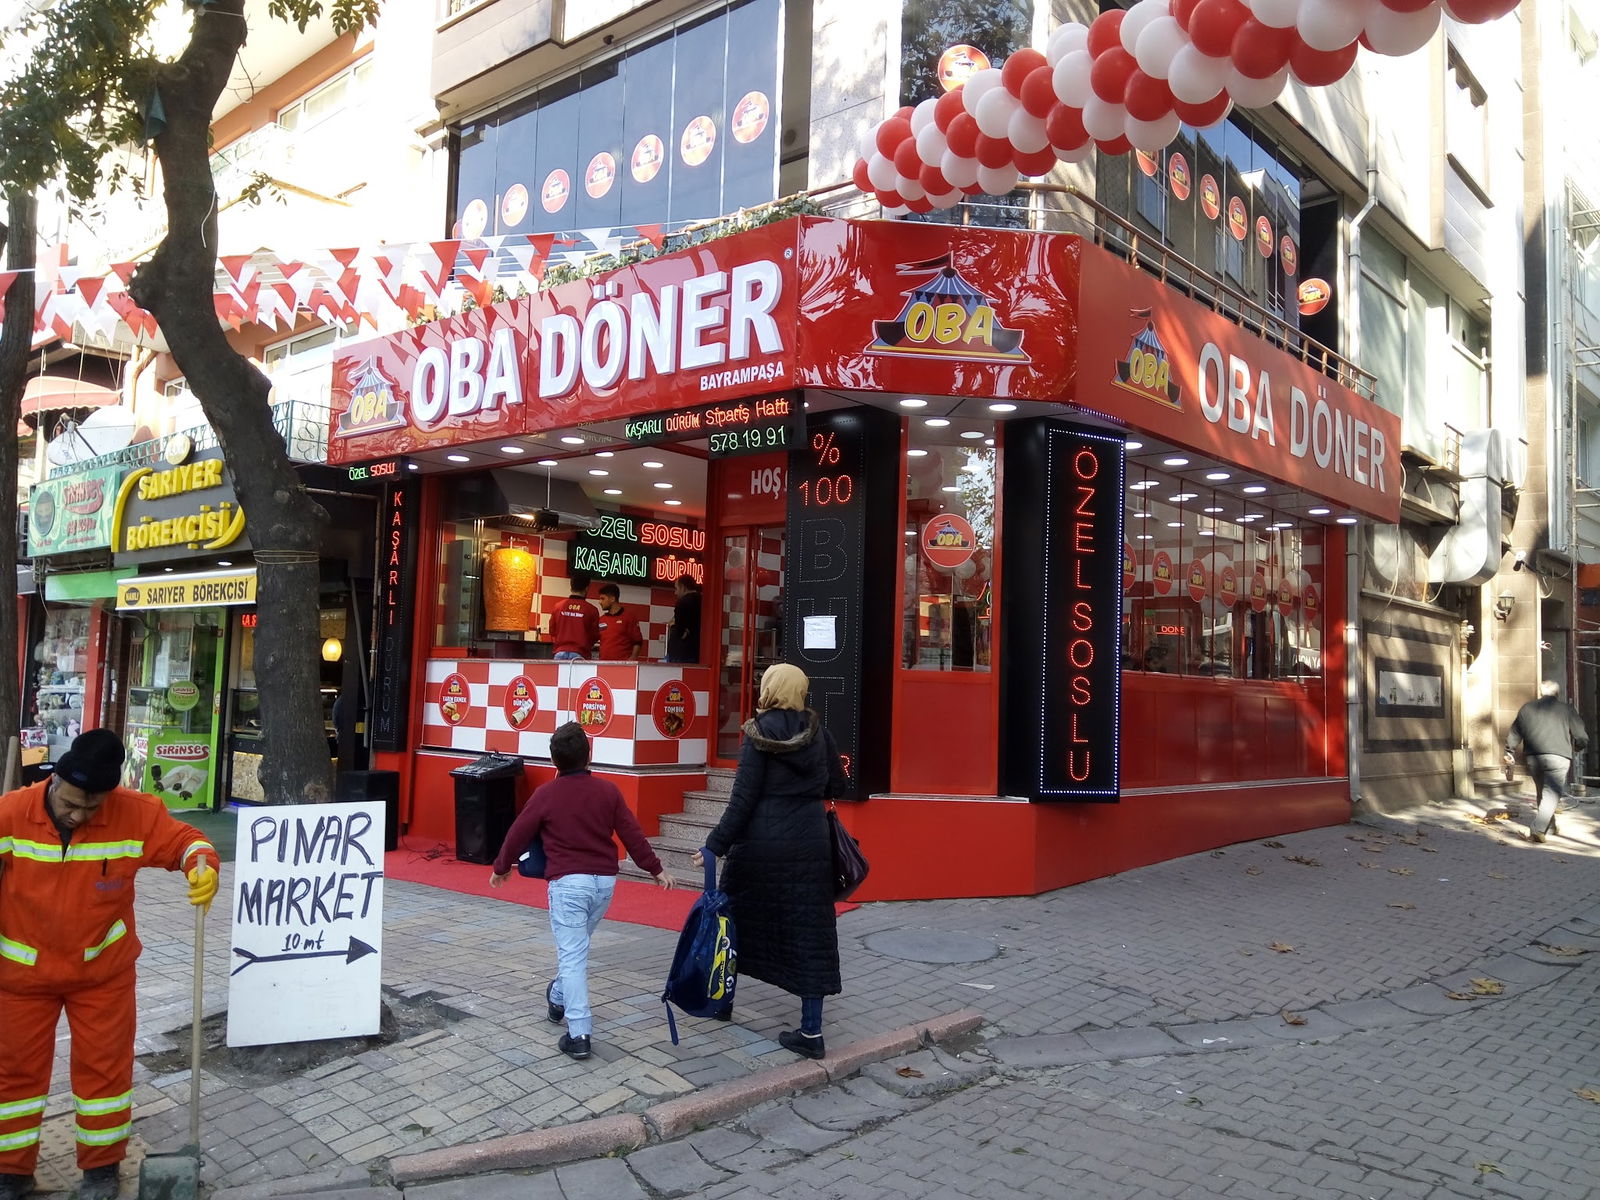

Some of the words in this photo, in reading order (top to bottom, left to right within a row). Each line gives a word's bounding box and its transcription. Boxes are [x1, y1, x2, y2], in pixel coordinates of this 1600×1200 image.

[412, 327, 525, 423] OBA
[539, 259, 786, 400] DÖNER
[904, 301, 994, 346] OBA
[700, 361, 784, 391] BAYRAMPAŞA
[1129, 349, 1170, 391] OBA
[350, 390, 388, 425] OBA
[705, 404, 750, 428] Sipariş
[1199, 342, 1276, 448] OBA
[1289, 385, 1387, 494] DÖNER
[625, 418, 662, 440] KAŞARLI
[710, 431, 739, 452] 578
[743, 428, 761, 449] 19
[766, 425, 785, 446] 91
[812, 431, 841, 467] %
[138, 458, 224, 501] SARIYER
[348, 466, 369, 481] ÖZEL
[370, 462, 396, 477] SOSLU
[751, 466, 781, 499] HOŞ
[799, 474, 852, 506] 100
[126, 501, 232, 551] BÖREKÇİSİ
[1074, 446, 1100, 589] ÖZEL
[641, 522, 705, 551] SOSLU
[936, 533, 962, 547] OBA
[387, 491, 402, 625] KAŞARLI
[575, 547, 647, 577] KAŞARLI
[147, 585, 185, 604] SARIYER
[1069, 602, 1095, 782] SOSLU
[250, 811, 375, 866] PINAR
[237, 872, 383, 926] MARKET
[281, 933, 302, 952] 10
[304, 930, 325, 950] mt
